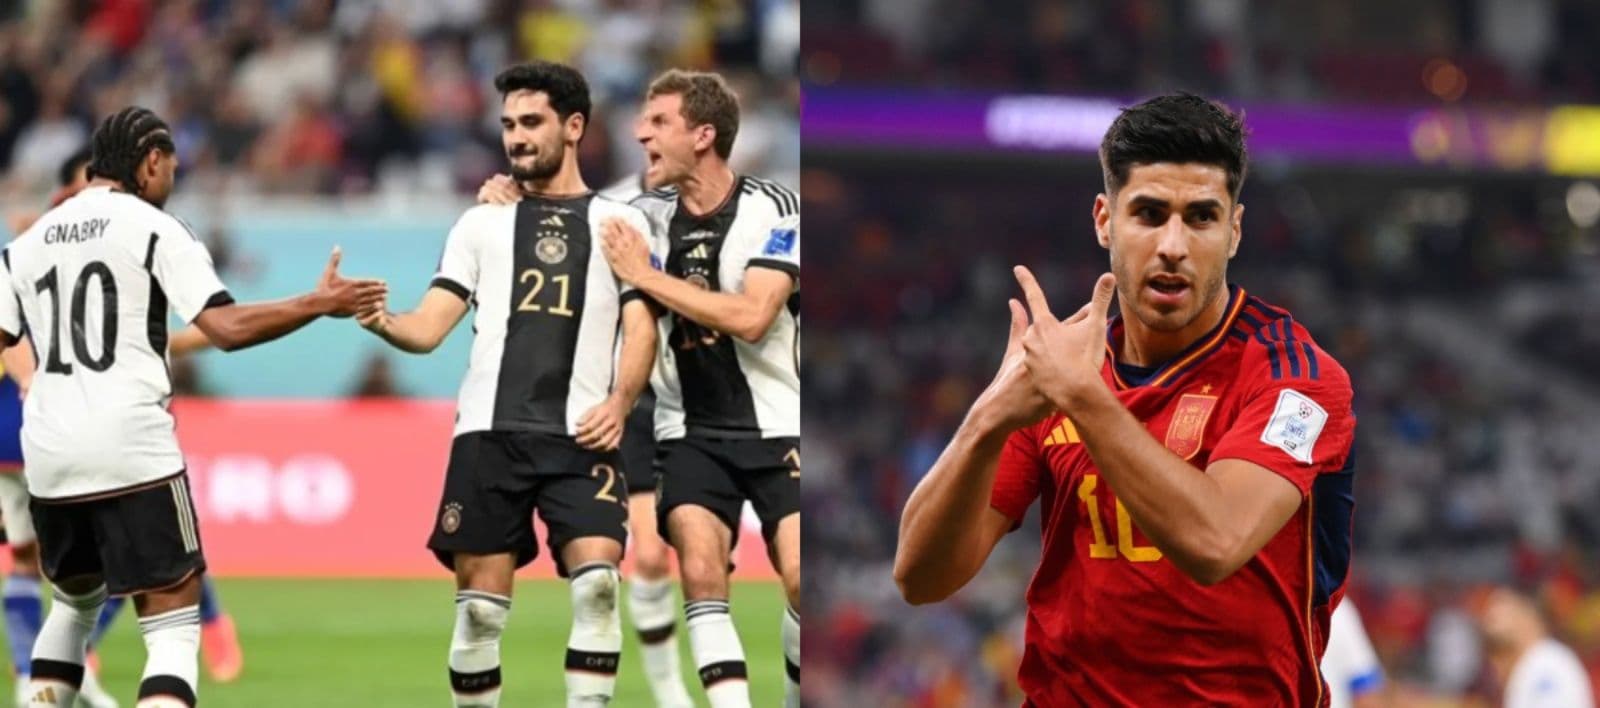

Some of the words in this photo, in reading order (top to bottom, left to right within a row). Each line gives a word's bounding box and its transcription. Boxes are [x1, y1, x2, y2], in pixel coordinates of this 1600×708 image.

[44, 219, 110, 244] GNABRY
[35, 261, 118, 375] 10
[517, 269, 573, 317] 21
[188, 455, 355, 524] RO
